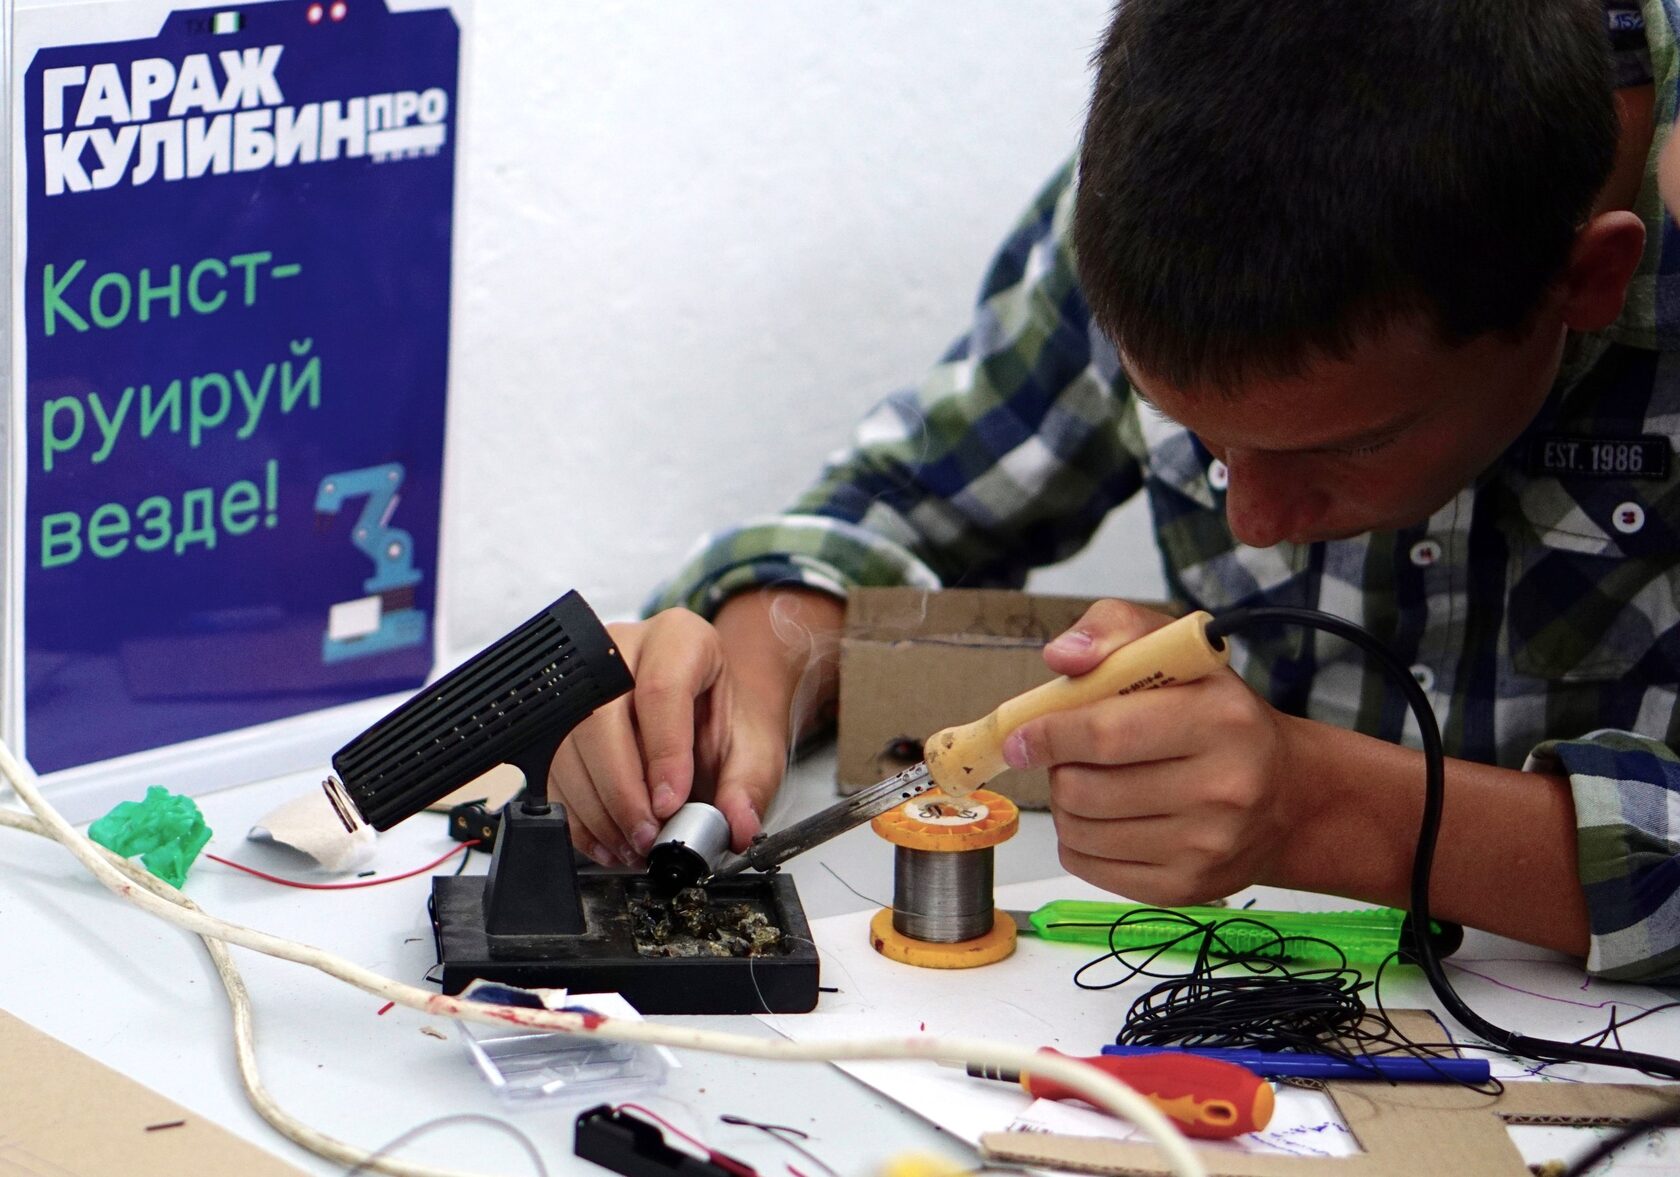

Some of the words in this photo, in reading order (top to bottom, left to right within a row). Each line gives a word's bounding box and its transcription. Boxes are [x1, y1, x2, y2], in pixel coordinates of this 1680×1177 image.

[43, 45, 285, 131] ГАРАЖ
[43, 252, 301, 336] Конст-
[43, 339, 321, 471] руируй
[1544, 442, 1583, 470] EST.
[1591, 444, 1643, 472] 1986
[41, 460, 278, 568] везде!
